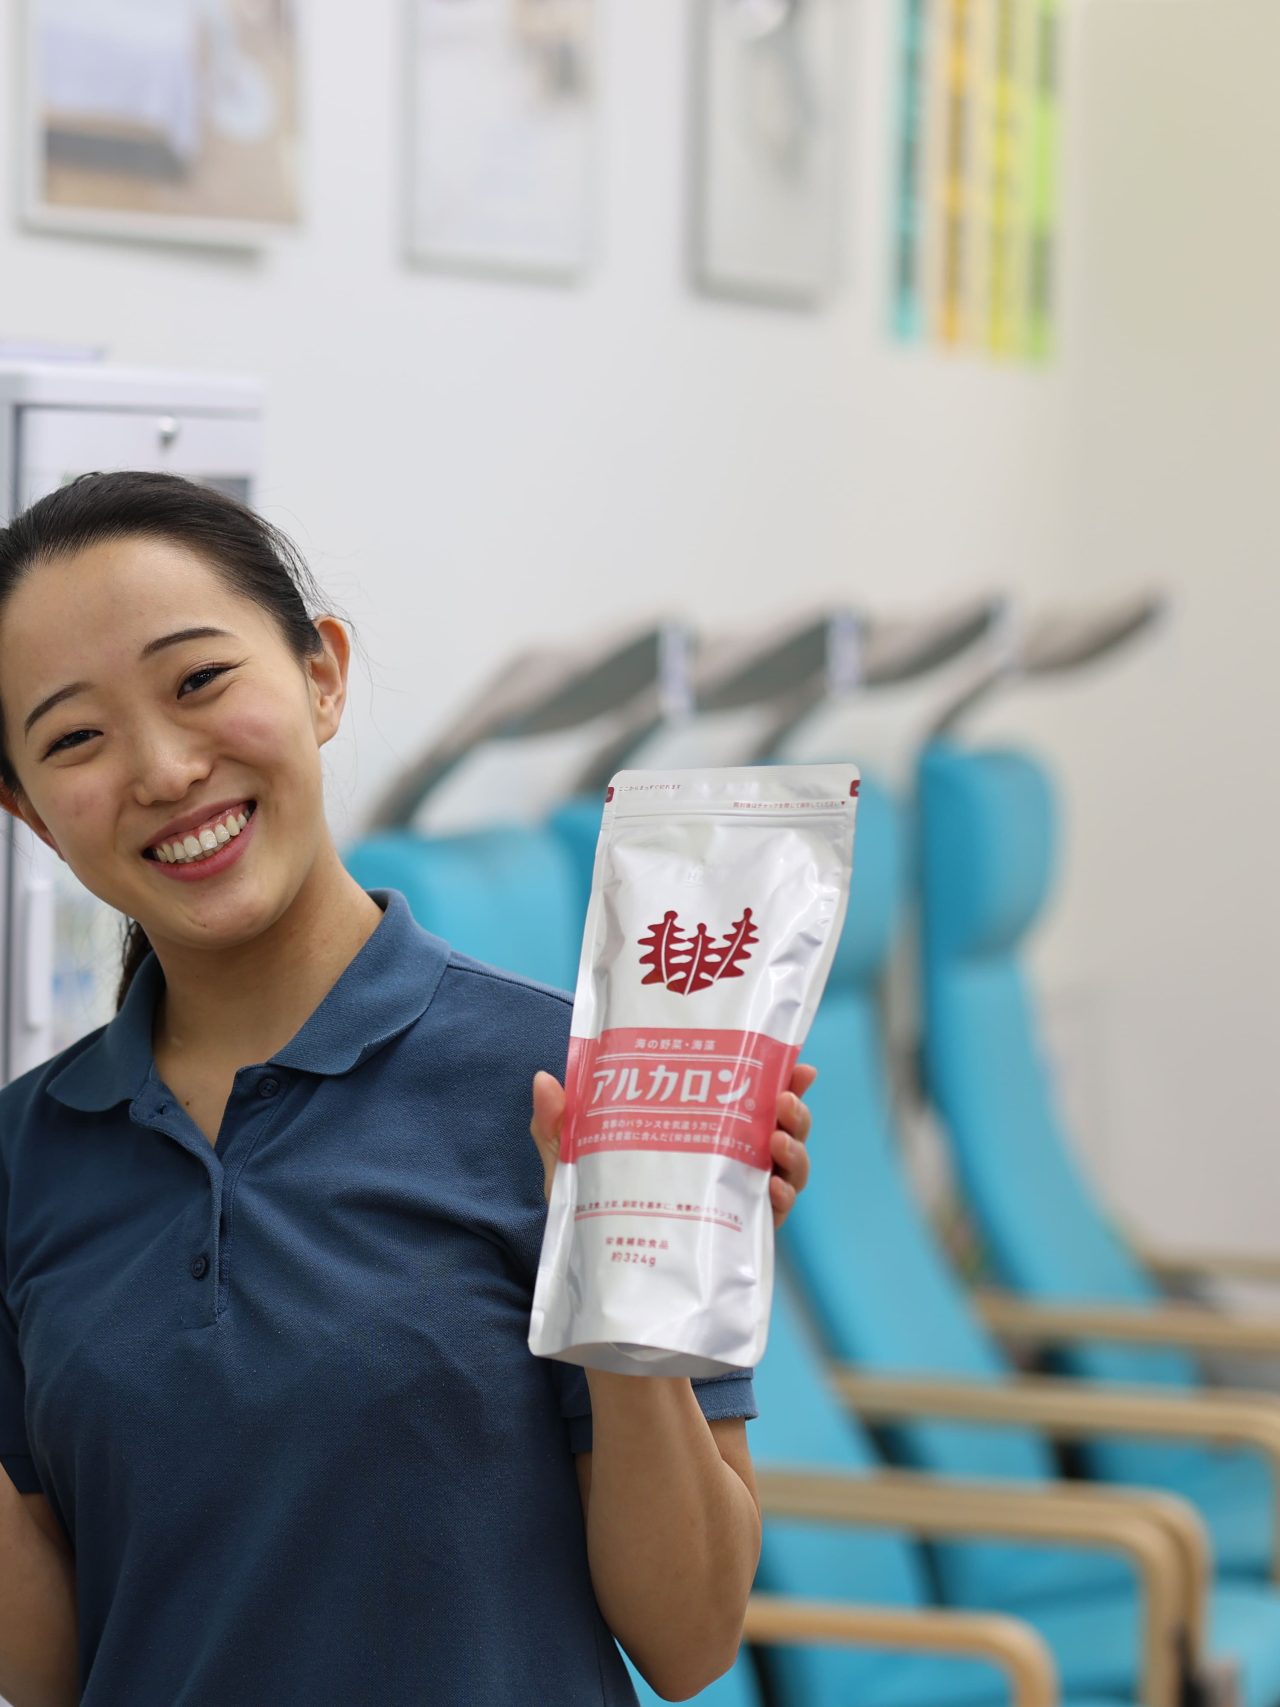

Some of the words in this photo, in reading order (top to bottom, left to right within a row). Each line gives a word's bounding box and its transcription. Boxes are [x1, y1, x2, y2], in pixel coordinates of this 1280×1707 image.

[634, 1037, 717, 1051] 海の野菜・海藻
[591, 1064, 752, 1105] アルカロン
[605, 1236, 670, 1250] 栄養補助食品
[611, 1251, 657, 1267] 約324g
